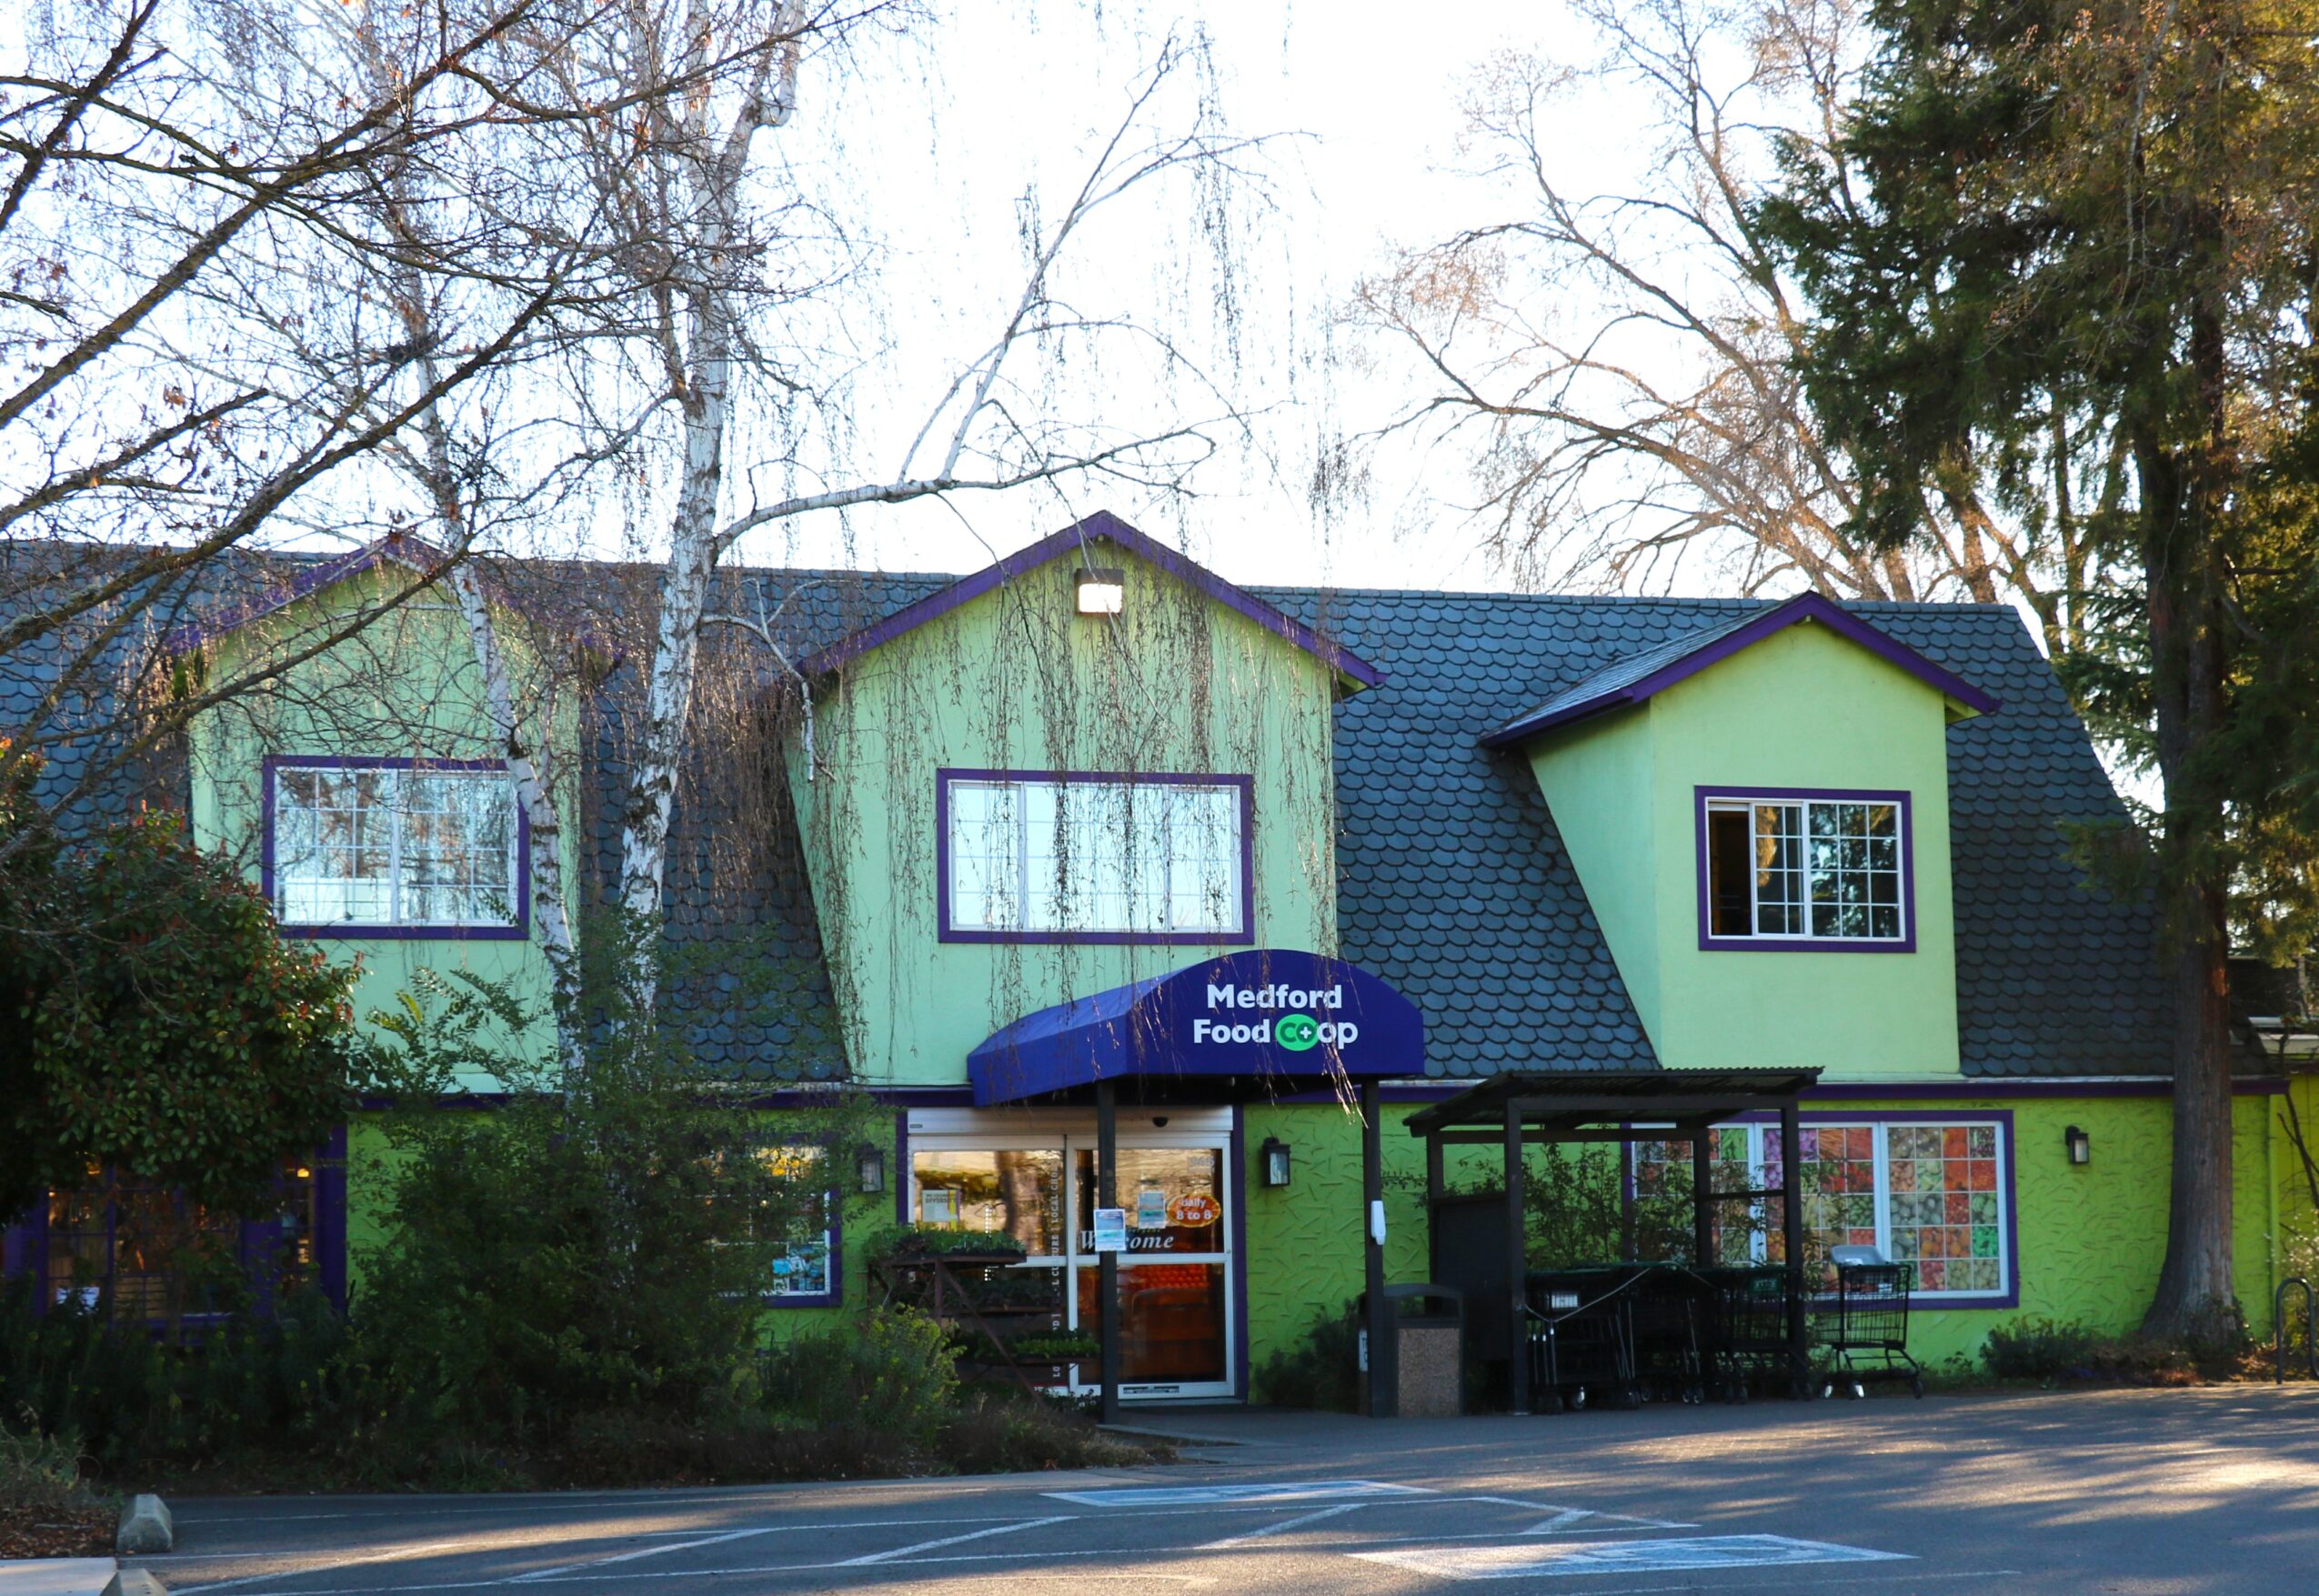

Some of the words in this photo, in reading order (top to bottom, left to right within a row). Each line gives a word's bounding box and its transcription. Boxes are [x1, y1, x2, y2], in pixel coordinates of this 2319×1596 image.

[1207, 984, 1342, 1009] Medford
[1193, 1019, 1270, 1044] Food
[1050, 1194, 1059, 1223] LOCAL
[1181, 1198, 1207, 1209] daily
[1187, 1210, 1200, 1220] to
[1203, 1210, 1212, 1220] 8
[1080, 1230, 1175, 1249] Wome
